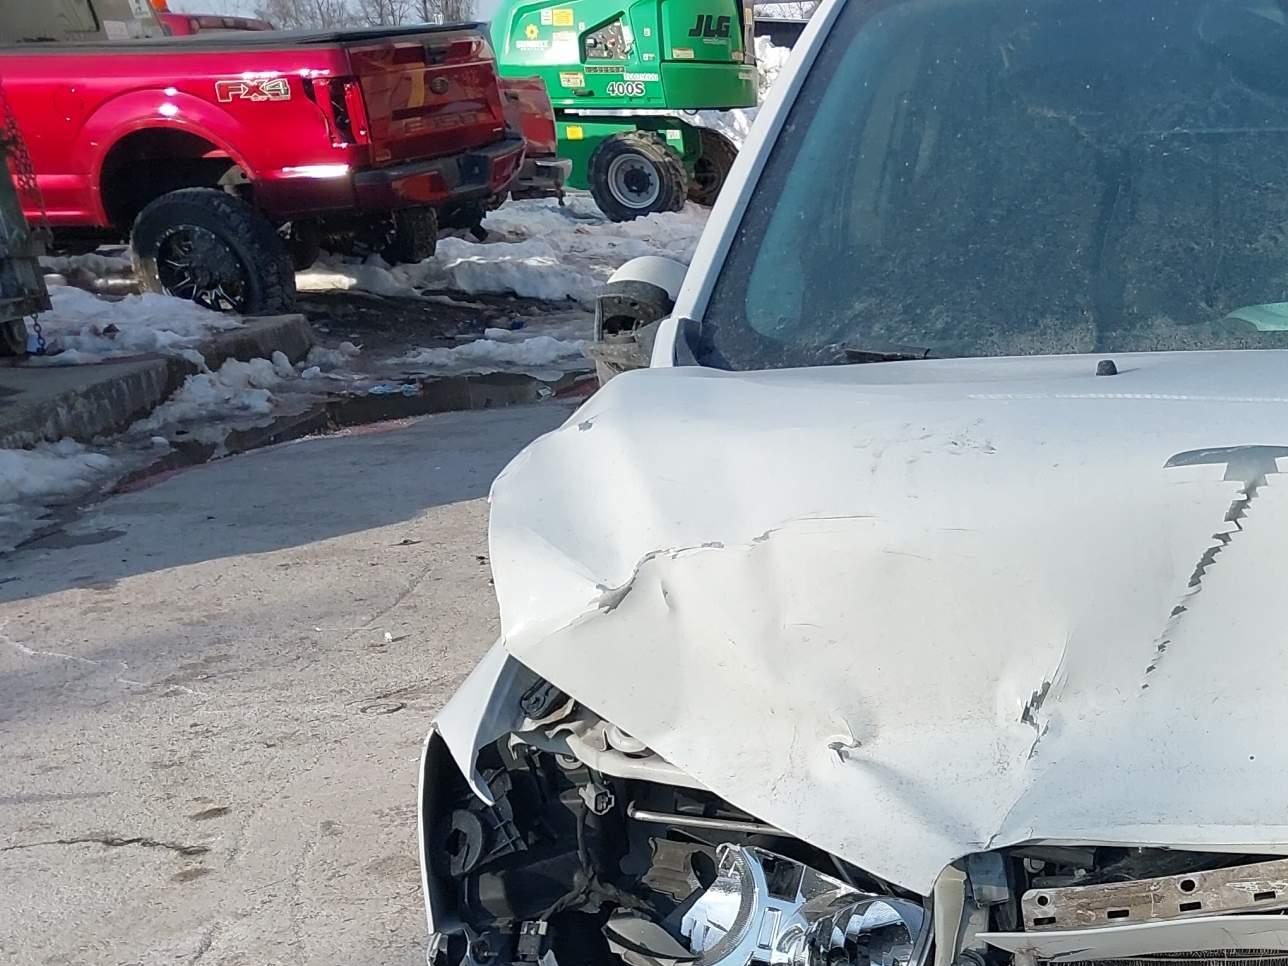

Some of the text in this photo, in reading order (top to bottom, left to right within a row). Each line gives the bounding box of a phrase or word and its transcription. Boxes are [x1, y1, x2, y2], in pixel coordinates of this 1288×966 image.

[688, 14, 732, 38] JLG
[215, 79, 290, 102] FX4
[607, 82, 645, 96] 400S
